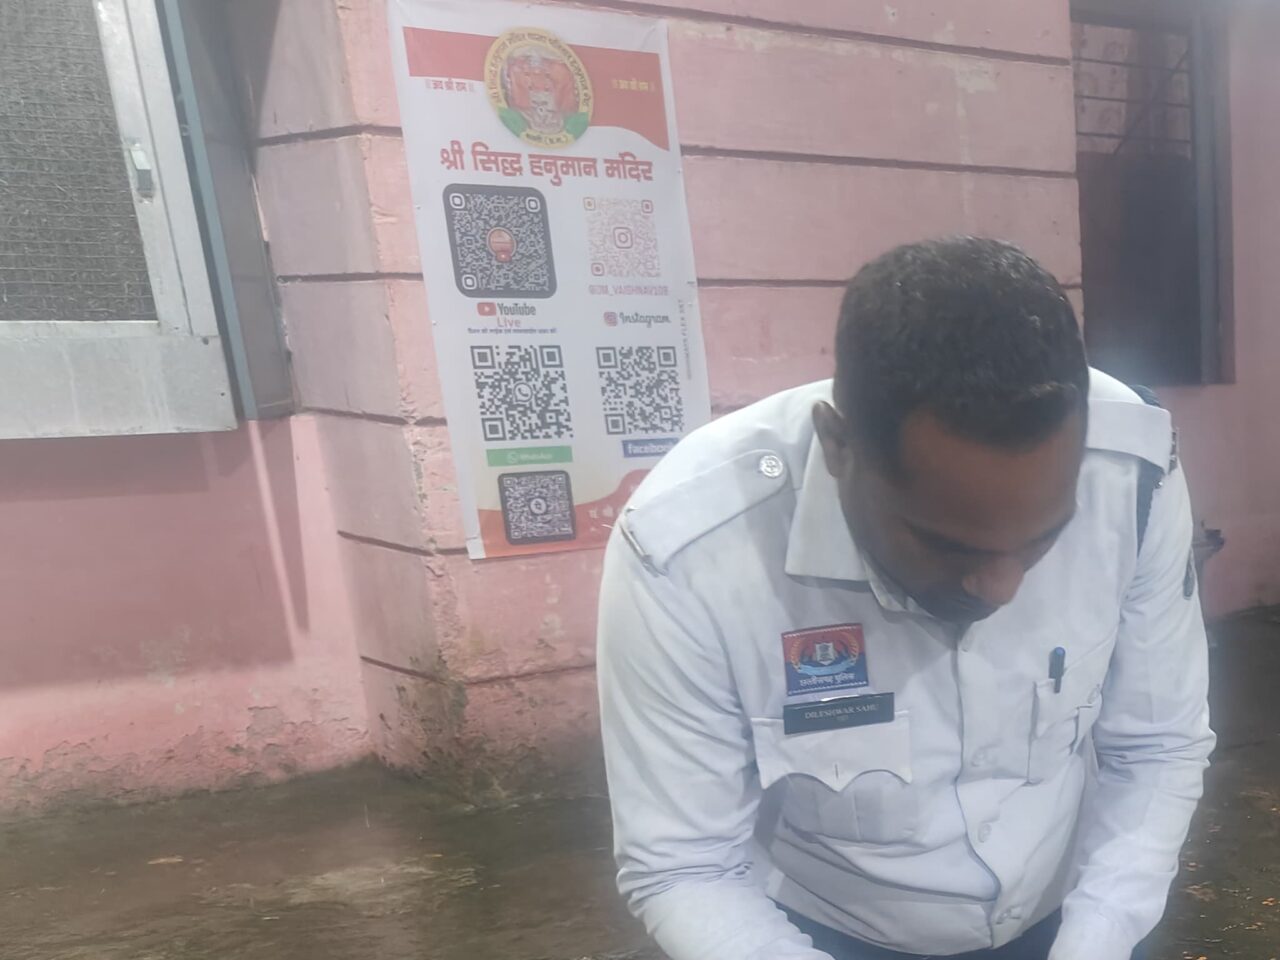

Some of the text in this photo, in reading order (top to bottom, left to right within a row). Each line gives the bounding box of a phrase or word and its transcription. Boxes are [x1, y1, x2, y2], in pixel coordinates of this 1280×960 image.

[440, 140, 653, 186] श्री सिद्ध हनुमान मंदिर
[497, 302, 536, 316] YouTube
[497, 317, 521, 328] Live
[619, 312, 671, 328] Instagram
